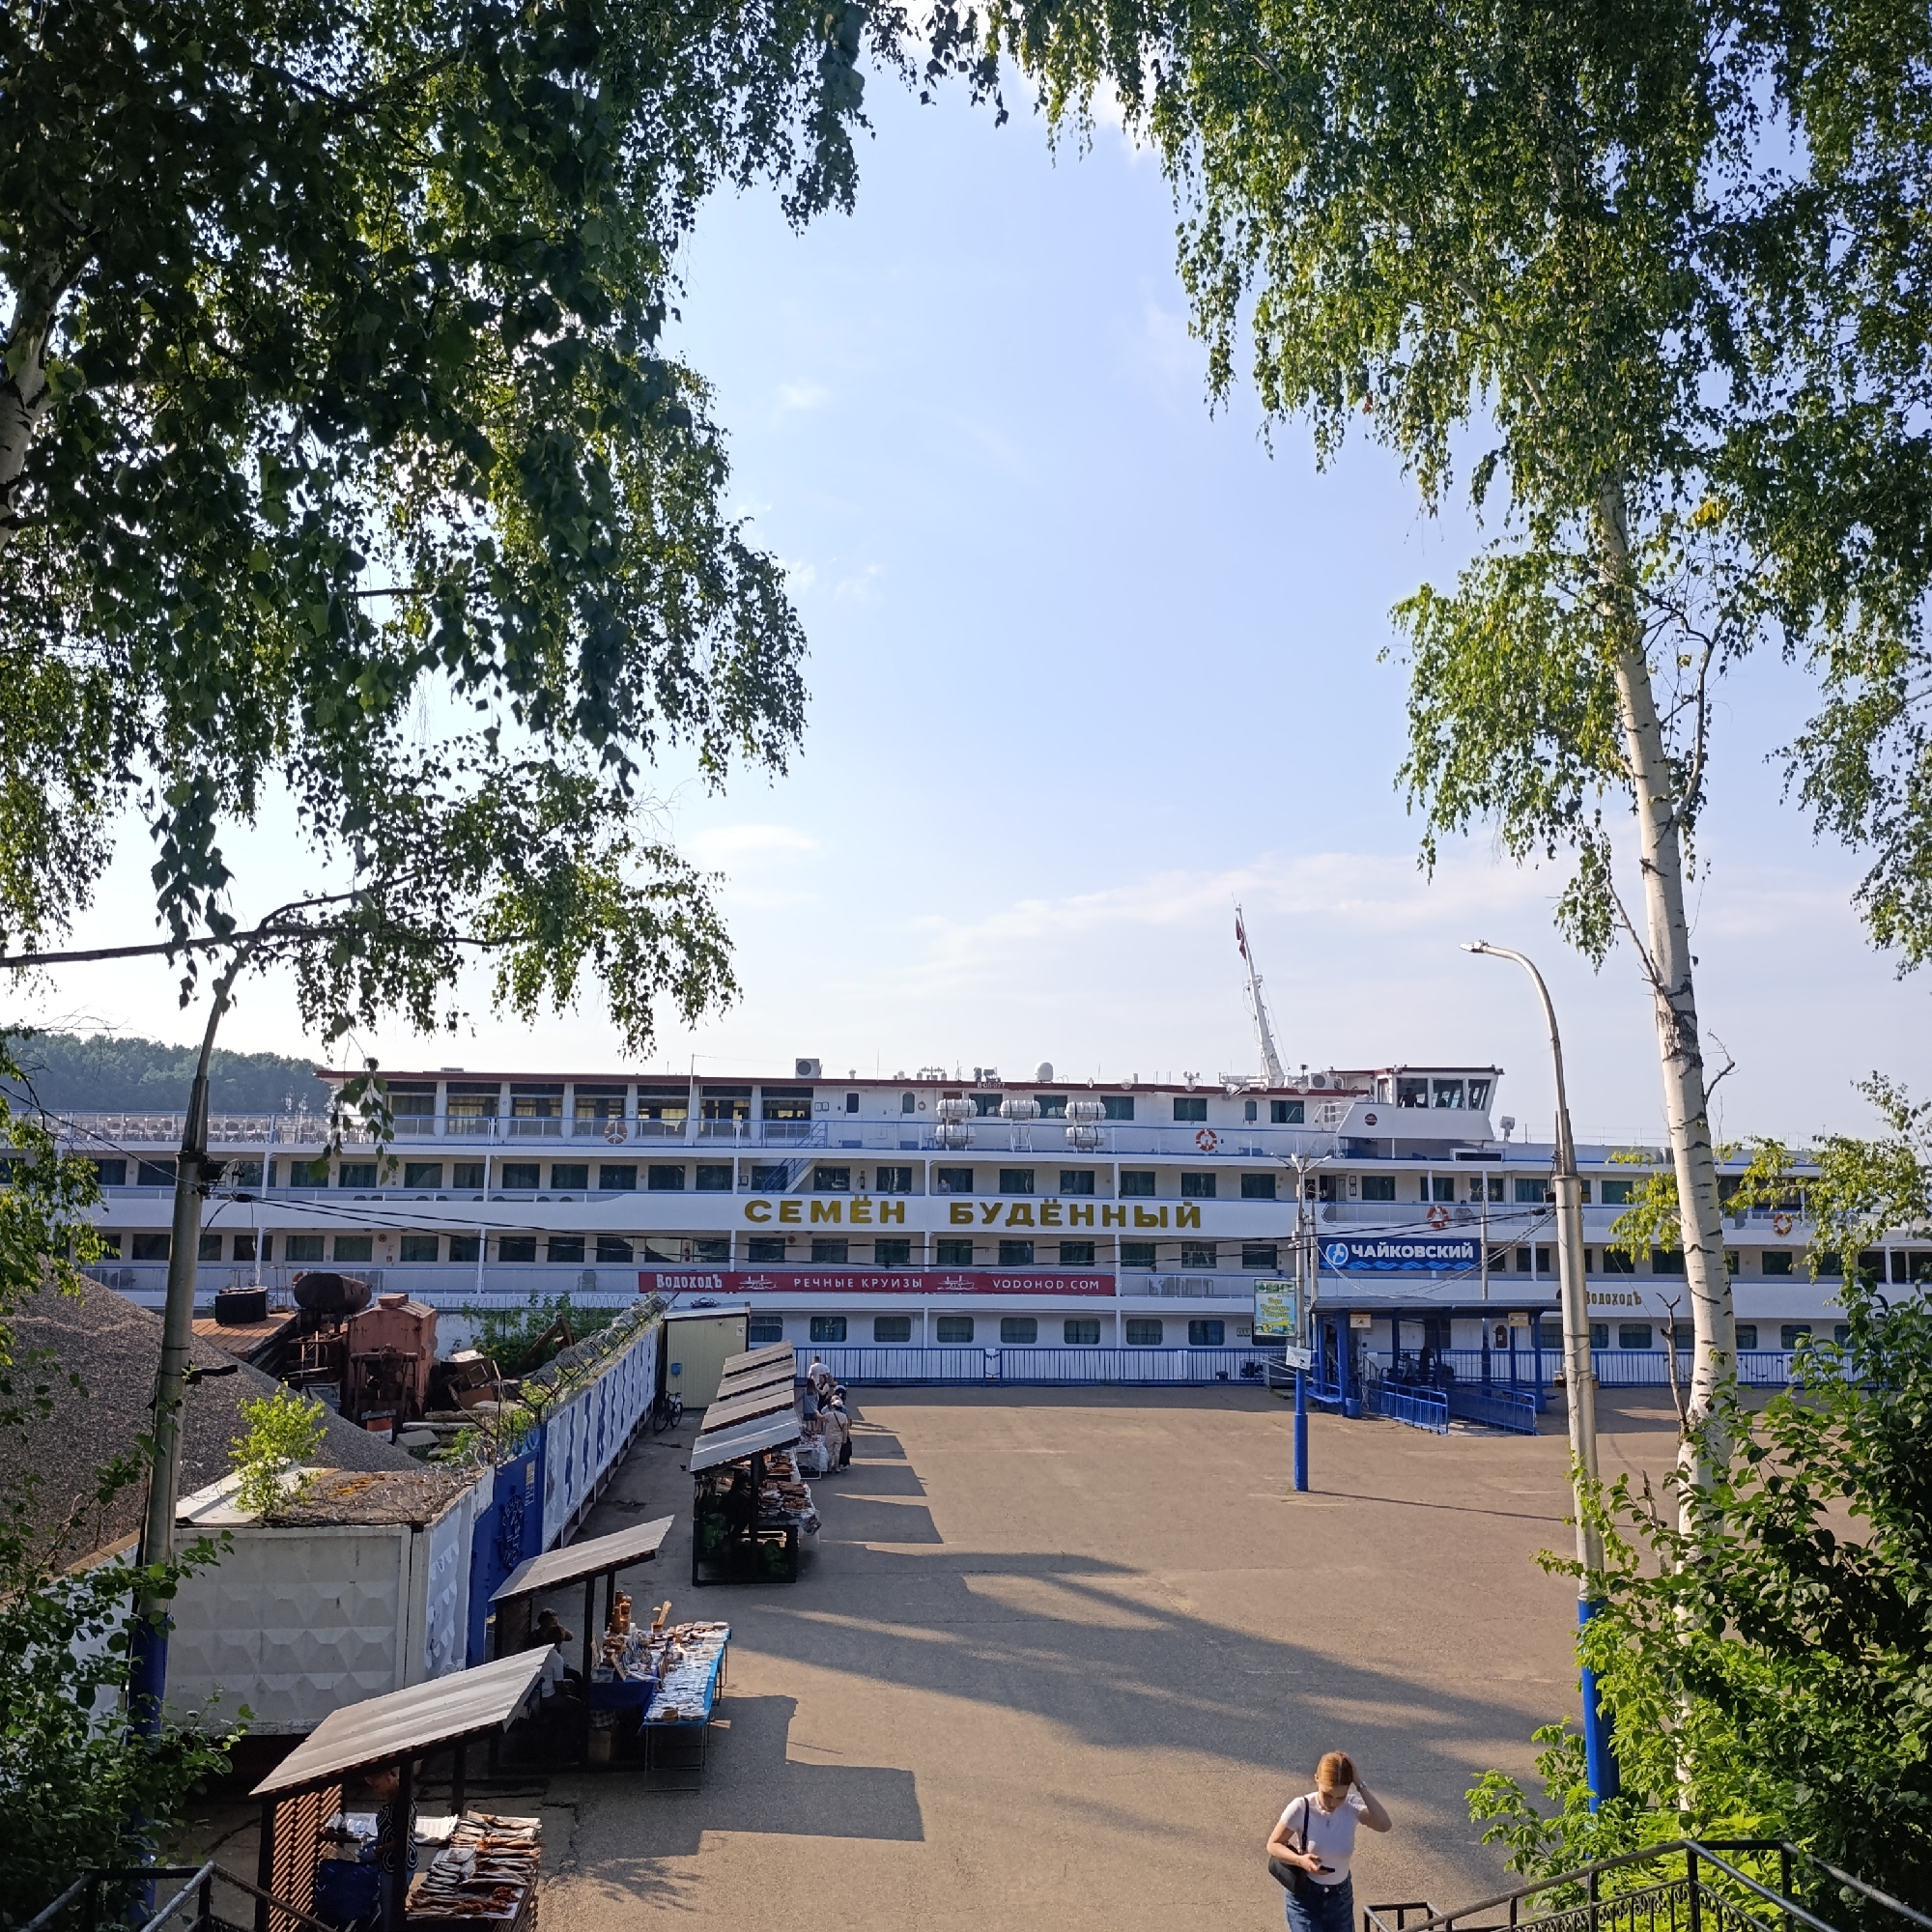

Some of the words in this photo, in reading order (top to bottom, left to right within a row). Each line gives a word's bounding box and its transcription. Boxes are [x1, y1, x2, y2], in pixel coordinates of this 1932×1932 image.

[744, 1194, 905, 1224] СЕМЁН
[950, 1198, 1201, 1229] БУДЁННЫЙ
[1351, 1241, 1473, 1259] ЧАЙКОВСКИЙ
[793, 1278, 854, 1289] РЕЧНЫЕ
[861, 1278, 923, 1289] КРУИЗЫ
[992, 1279, 1099, 1291] VODOHOD.COM
